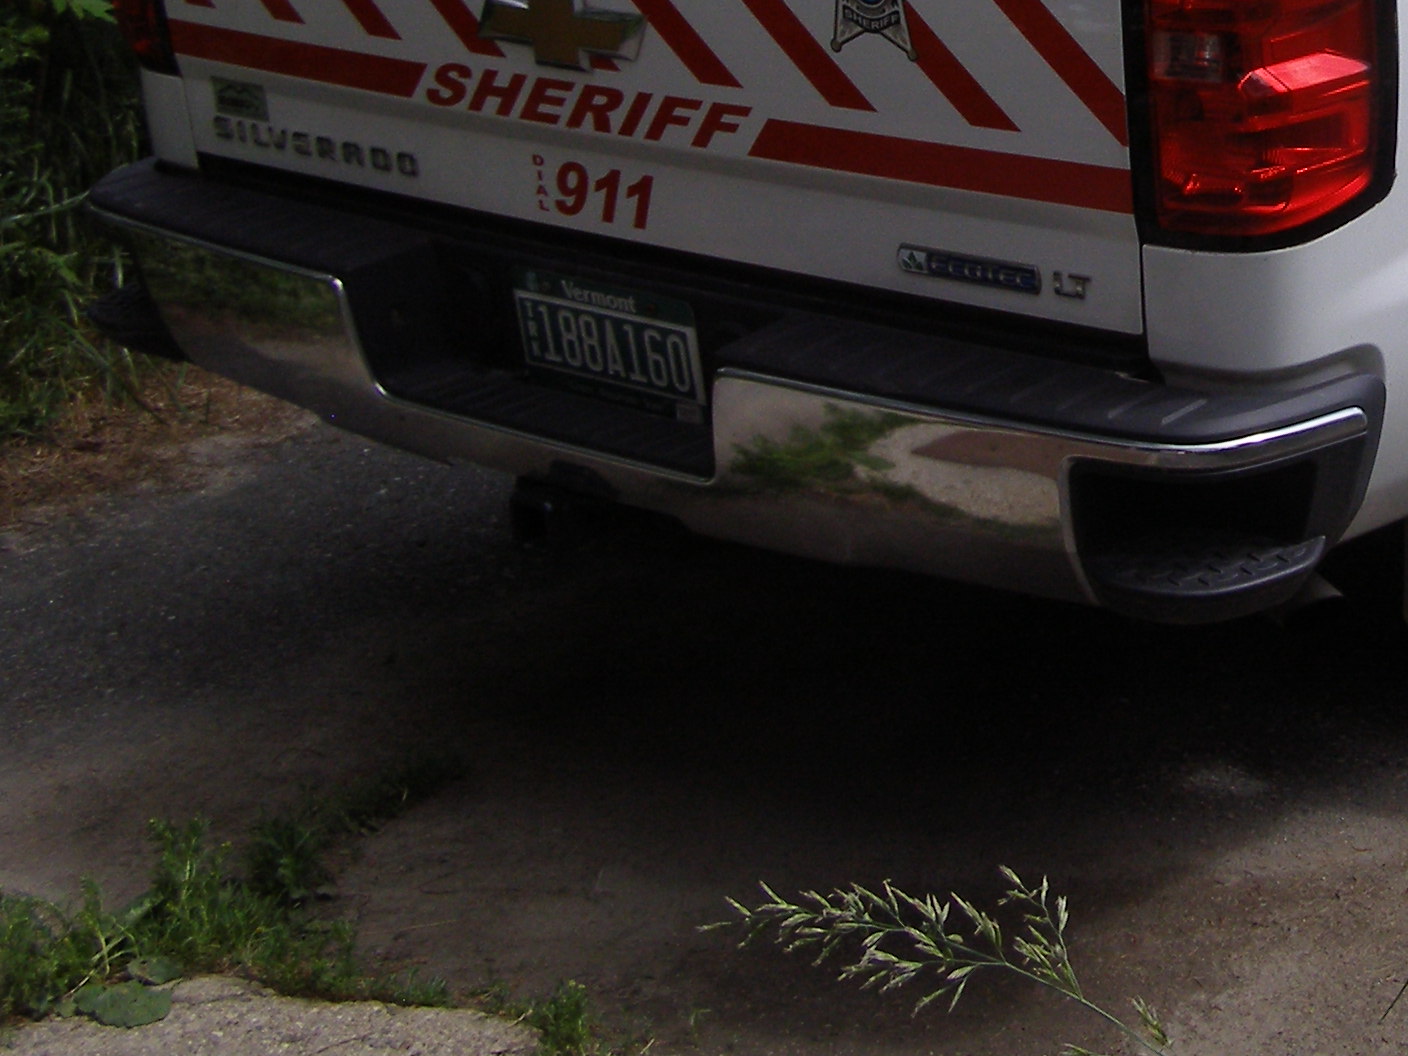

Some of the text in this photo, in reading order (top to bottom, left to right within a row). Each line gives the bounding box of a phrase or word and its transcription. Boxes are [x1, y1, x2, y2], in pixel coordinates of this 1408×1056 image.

[844, 8, 899, 30] SHERIFF
[426, 63, 752, 147] SHERIFF
[214, 115, 420, 177] SILVERADO
[532, 154, 653, 230] DIAL 911
[561, 280, 637, 313] Vermont
[1053, 270, 1092, 299] LT
[538, 304, 690, 393] 188A160
